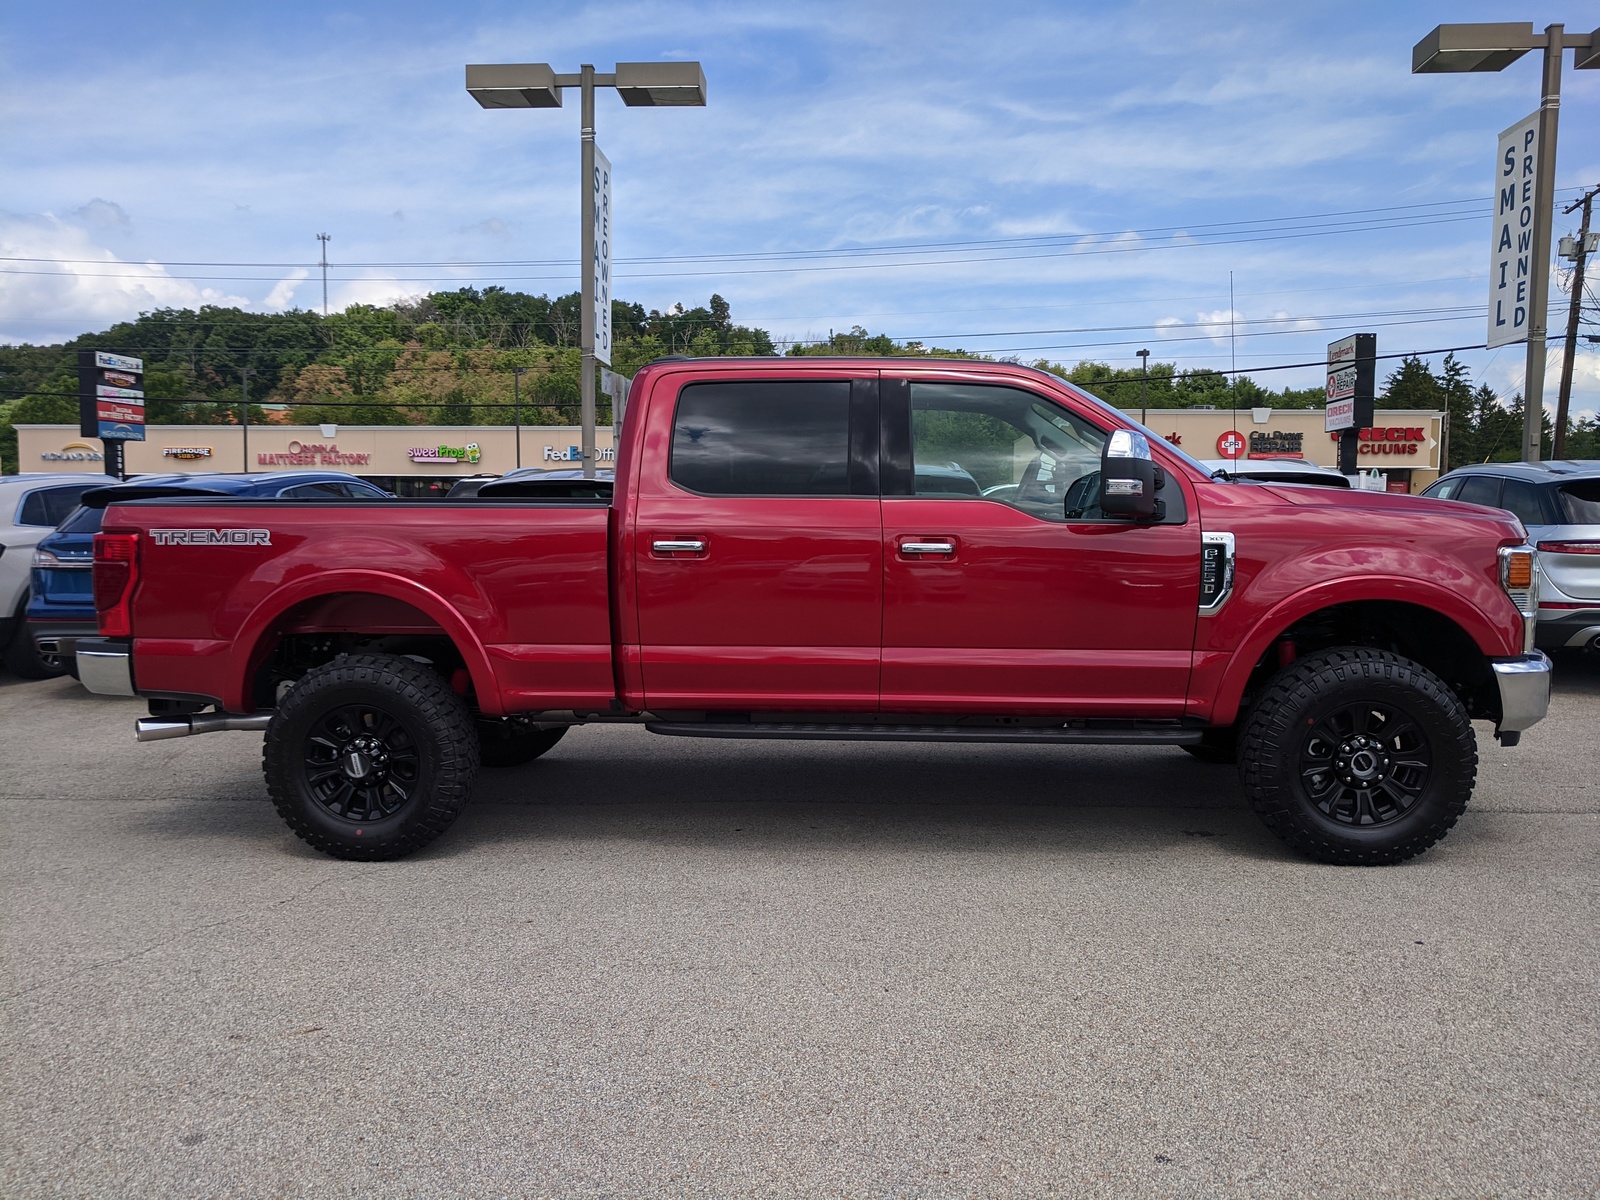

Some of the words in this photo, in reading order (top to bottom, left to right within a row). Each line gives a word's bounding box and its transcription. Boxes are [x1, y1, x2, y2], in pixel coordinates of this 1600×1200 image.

[1514, 129, 1534, 328] PREOWNED
[1496, 145, 1516, 328] SMAIL
[601, 170, 609, 350] PREOWNED
[98, 354, 116, 366] FedEx
[1336, 378, 1355, 391] REPAIR
[1327, 402, 1353, 418] ORECK
[1328, 415, 1352, 427] VACUUMS
[163, 447, 210, 457] FIREHOUSE
[1250, 440, 1302, 453] REPAIR
[256, 453, 317, 466] MATTRESS
[320, 453, 372, 466] FACTORY
[149, 528, 272, 546] TREMOR
